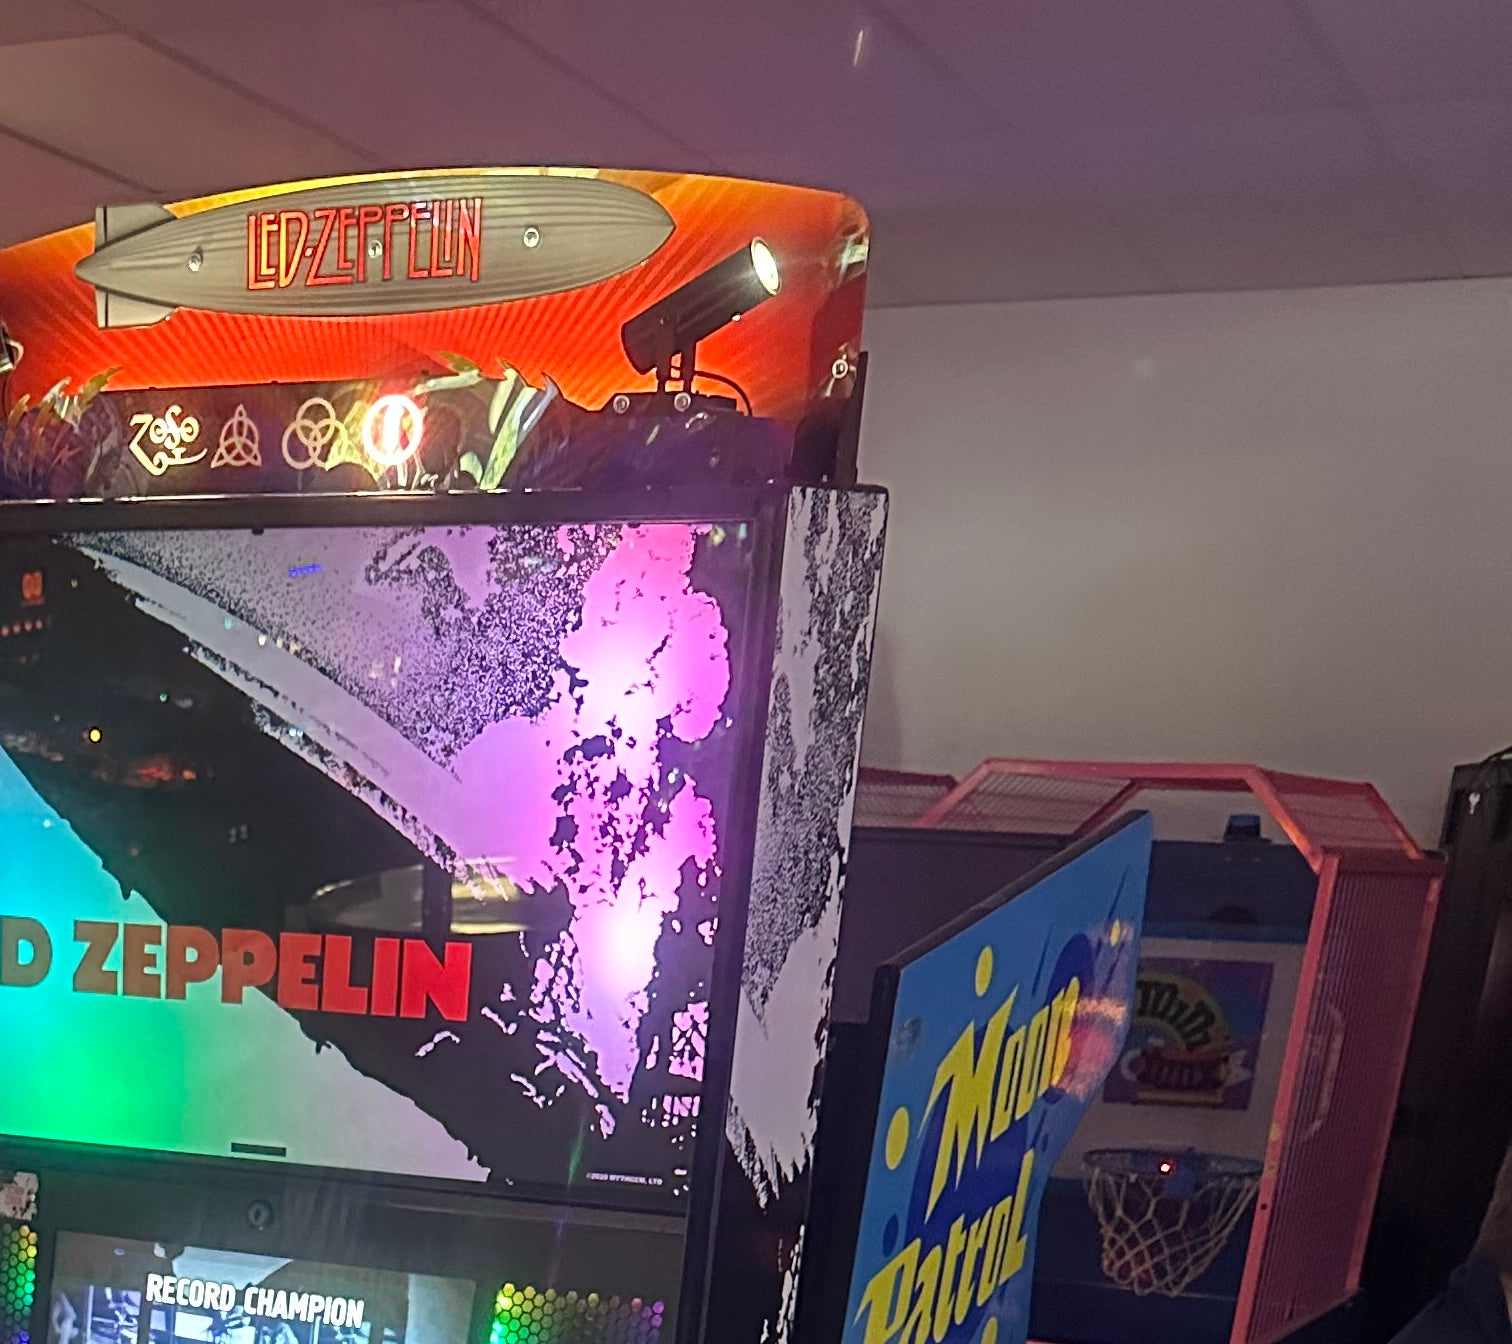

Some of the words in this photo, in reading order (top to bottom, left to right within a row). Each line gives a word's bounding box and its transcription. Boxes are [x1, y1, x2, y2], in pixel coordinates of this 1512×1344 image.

[73, 918, 474, 1023] ZEPPELIN
[919, 976, 1081, 1225] Moon
[146, 1273, 236, 1312] RECORD
[243, 1286, 365, 1329] CHAMPION
